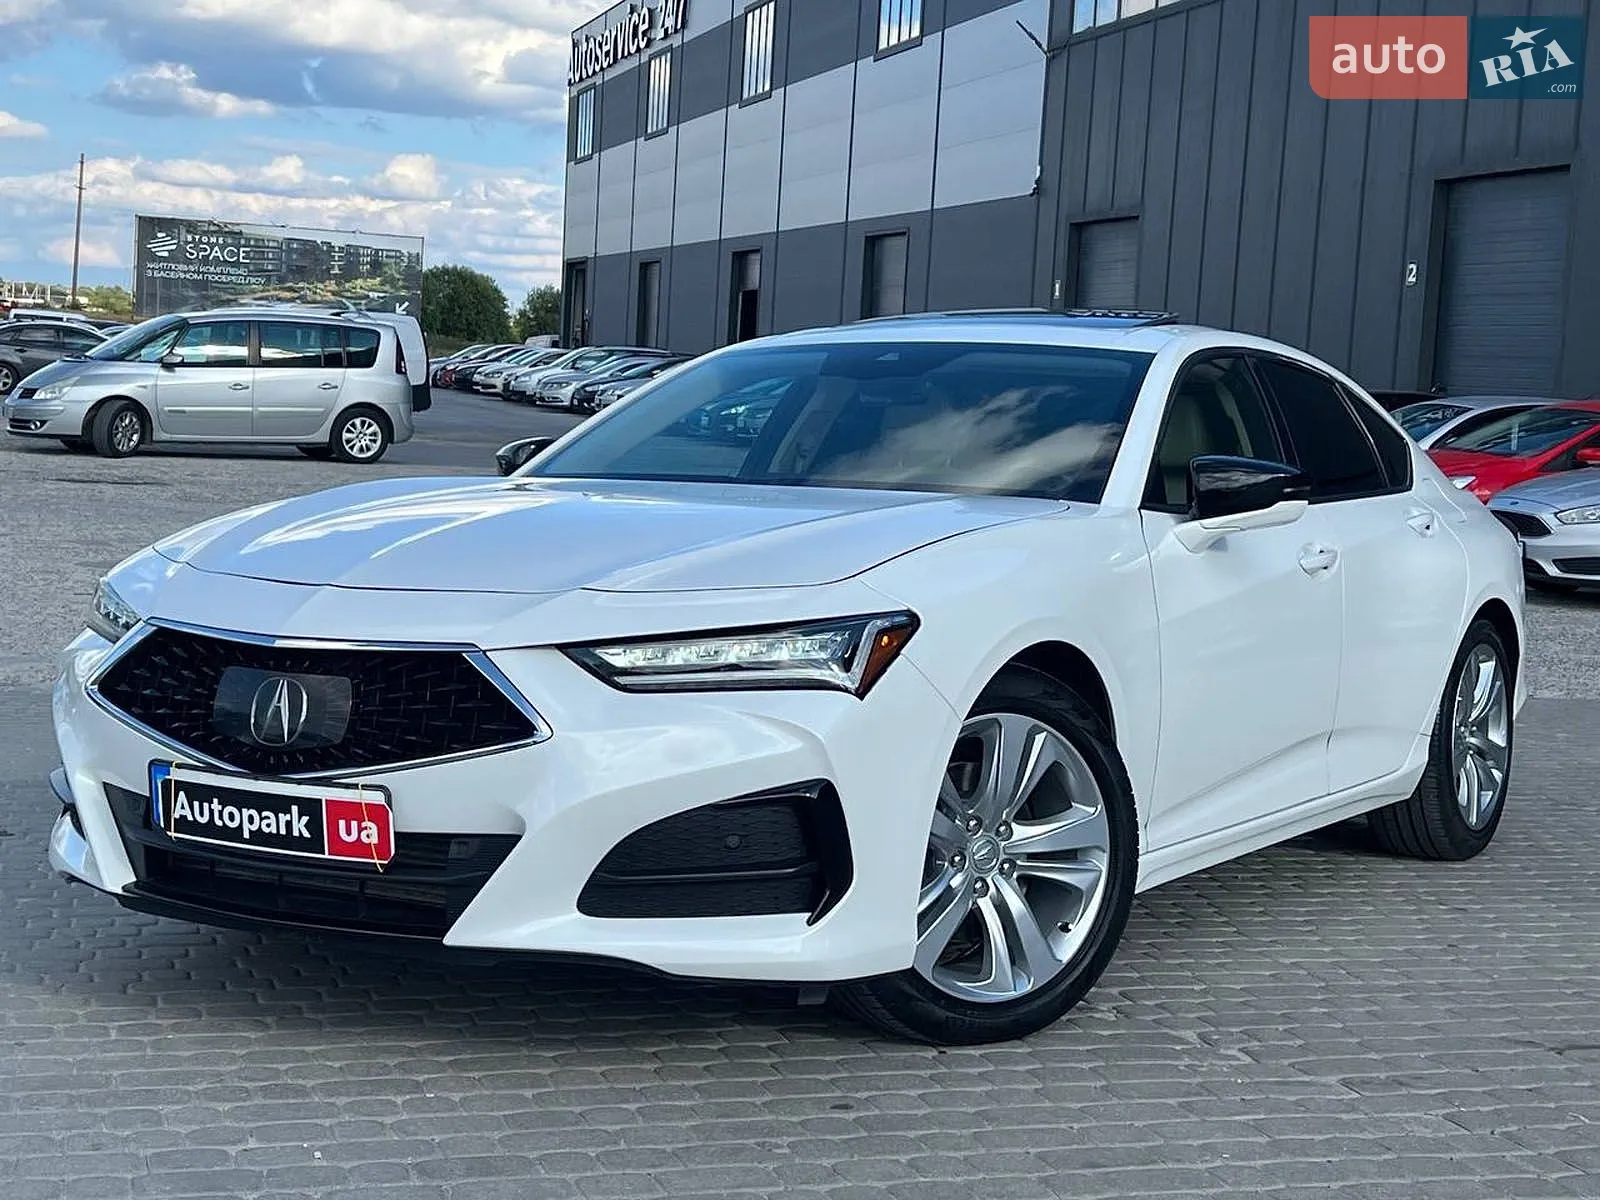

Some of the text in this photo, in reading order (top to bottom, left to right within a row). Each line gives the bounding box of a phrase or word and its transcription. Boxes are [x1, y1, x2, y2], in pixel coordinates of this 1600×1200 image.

[568, 5, 650, 84] Autoservice
[186, 234, 224, 244] STONE
[185, 243, 251, 263] SPACE
[1407, 263, 1417, 282] 2
[173, 790, 379, 845] Autopark ua
